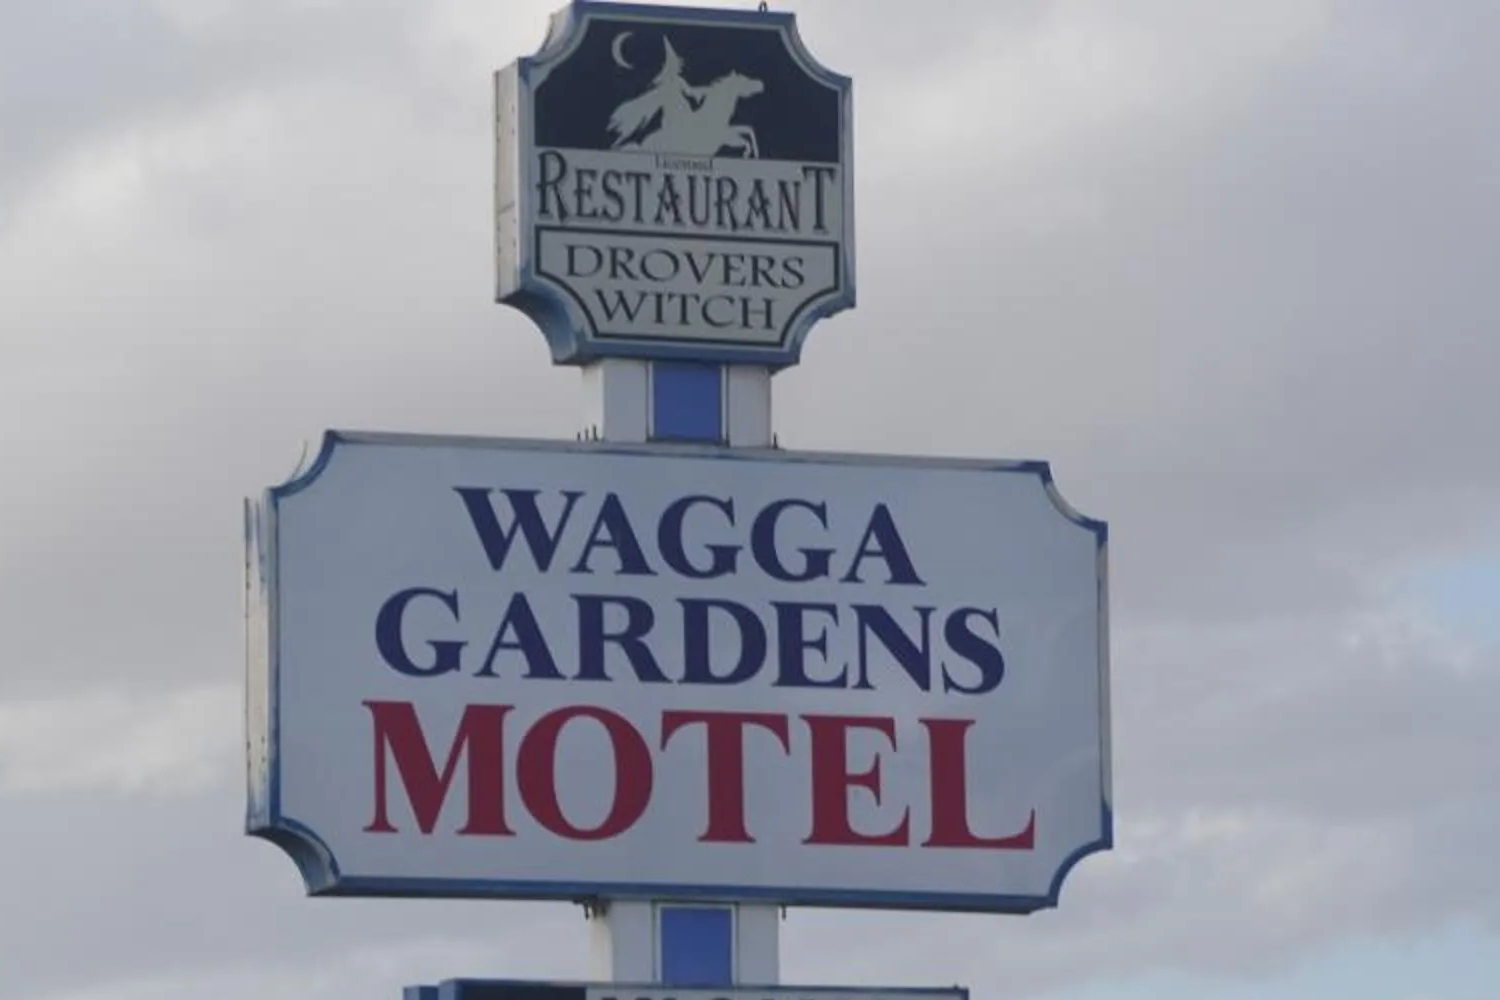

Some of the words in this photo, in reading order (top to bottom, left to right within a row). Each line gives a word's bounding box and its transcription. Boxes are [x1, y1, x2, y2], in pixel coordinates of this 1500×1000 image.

[536, 150, 837, 231] RESTAURANT
[564, 244, 805, 288] DROVERS
[596, 290, 775, 330] WITCH
[453, 486, 927, 586] WAGGA
[375, 587, 1005, 694] GARDENS
[362, 700, 1036, 850] MOTEL
